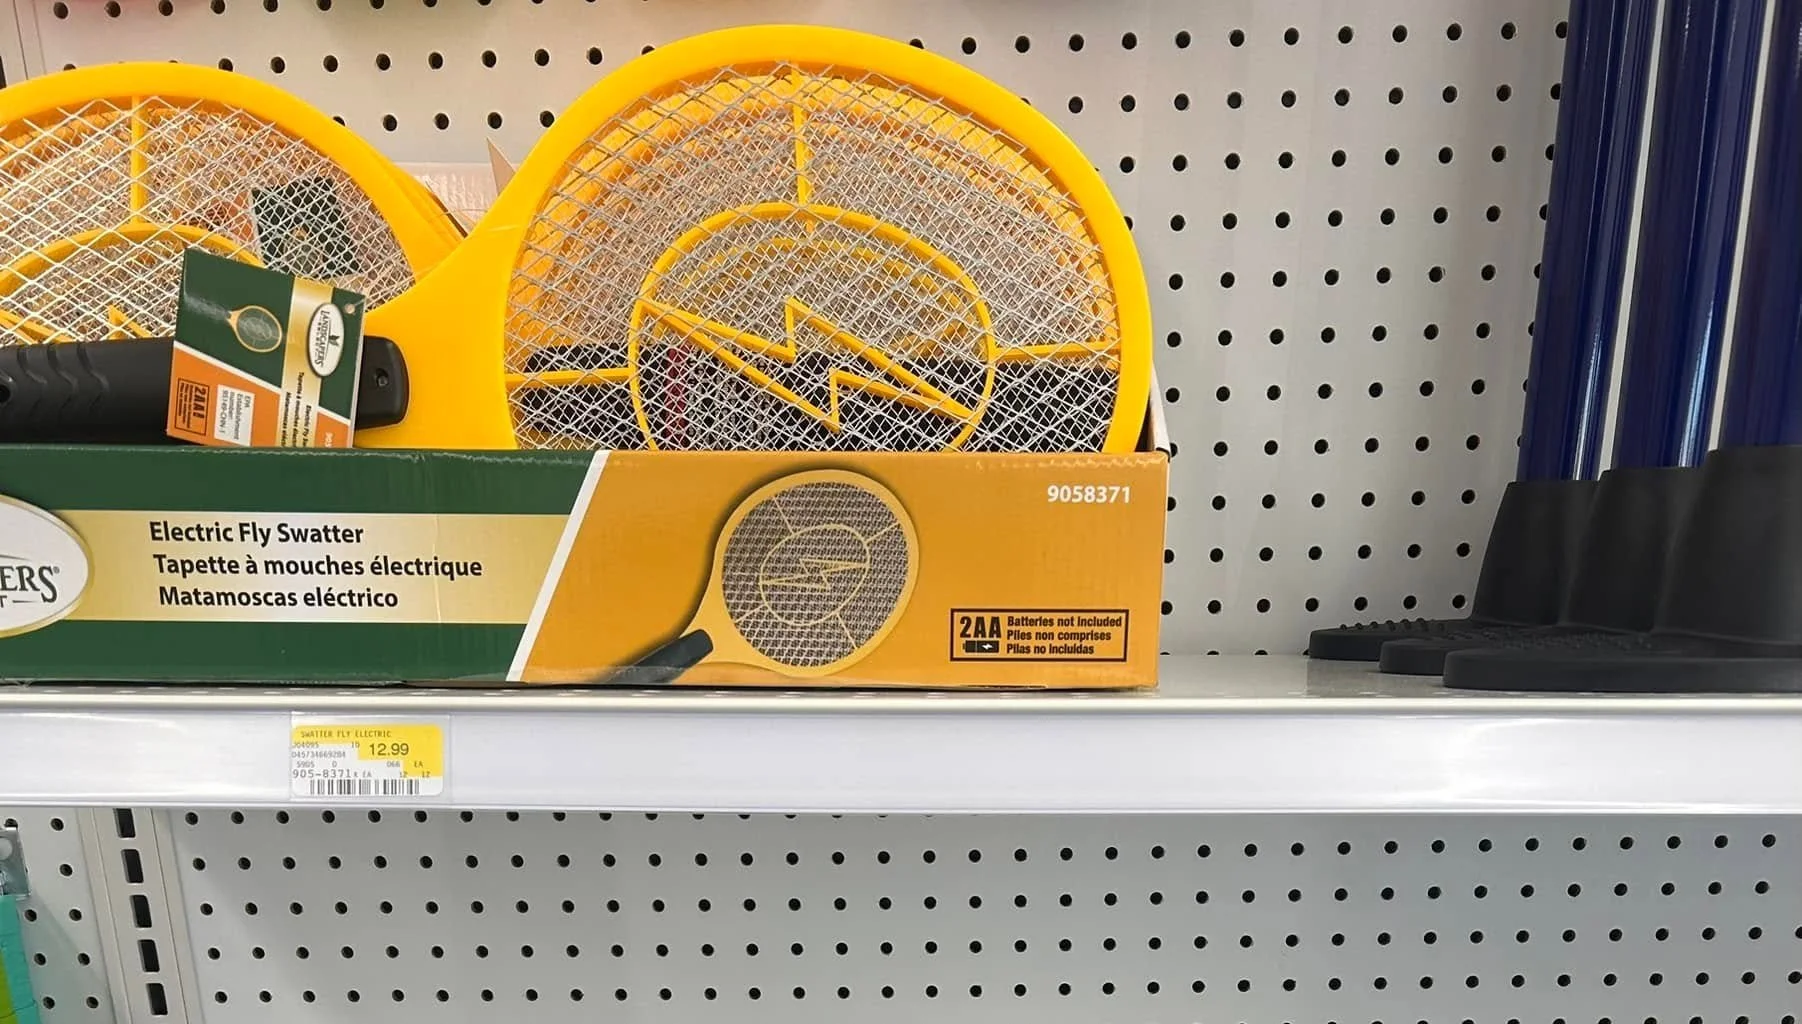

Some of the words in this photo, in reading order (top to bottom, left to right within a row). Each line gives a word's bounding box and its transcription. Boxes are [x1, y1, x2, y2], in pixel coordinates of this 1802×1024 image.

[314, 310, 330, 368] LANDSCAPERS
[243, 395, 251, 408] EPA
[234, 393, 243, 440] Establishment
[1047, 485, 1130, 503] 9058371
[150, 522, 233, 542] Electric
[238, 523, 271, 547] Fly
[277, 523, 364, 543] Swatter
[153, 554, 240, 579] Tapette
[247, 554, 258, 575] à
[264, 555, 364, 576] mouches
[371, 555, 482, 581] électrique
[159, 586, 297, 607] Matamoscas
[304, 587, 398, 607] eléctrico
[960, 616, 1001, 638] 2AA
[1007, 616, 1054, 627] Batteries
[1057, 616, 1075, 627] not
[1007, 630, 1032, 640] Piles
[1035, 632, 1054, 640] non
[1057, 630, 1111, 642] comprises
[1007, 644, 1031, 654] Pilas
[1034, 645, 1046, 654] no
[369, 743, 409, 756] 12.99
[292, 769, 351, 778] 905-8371
